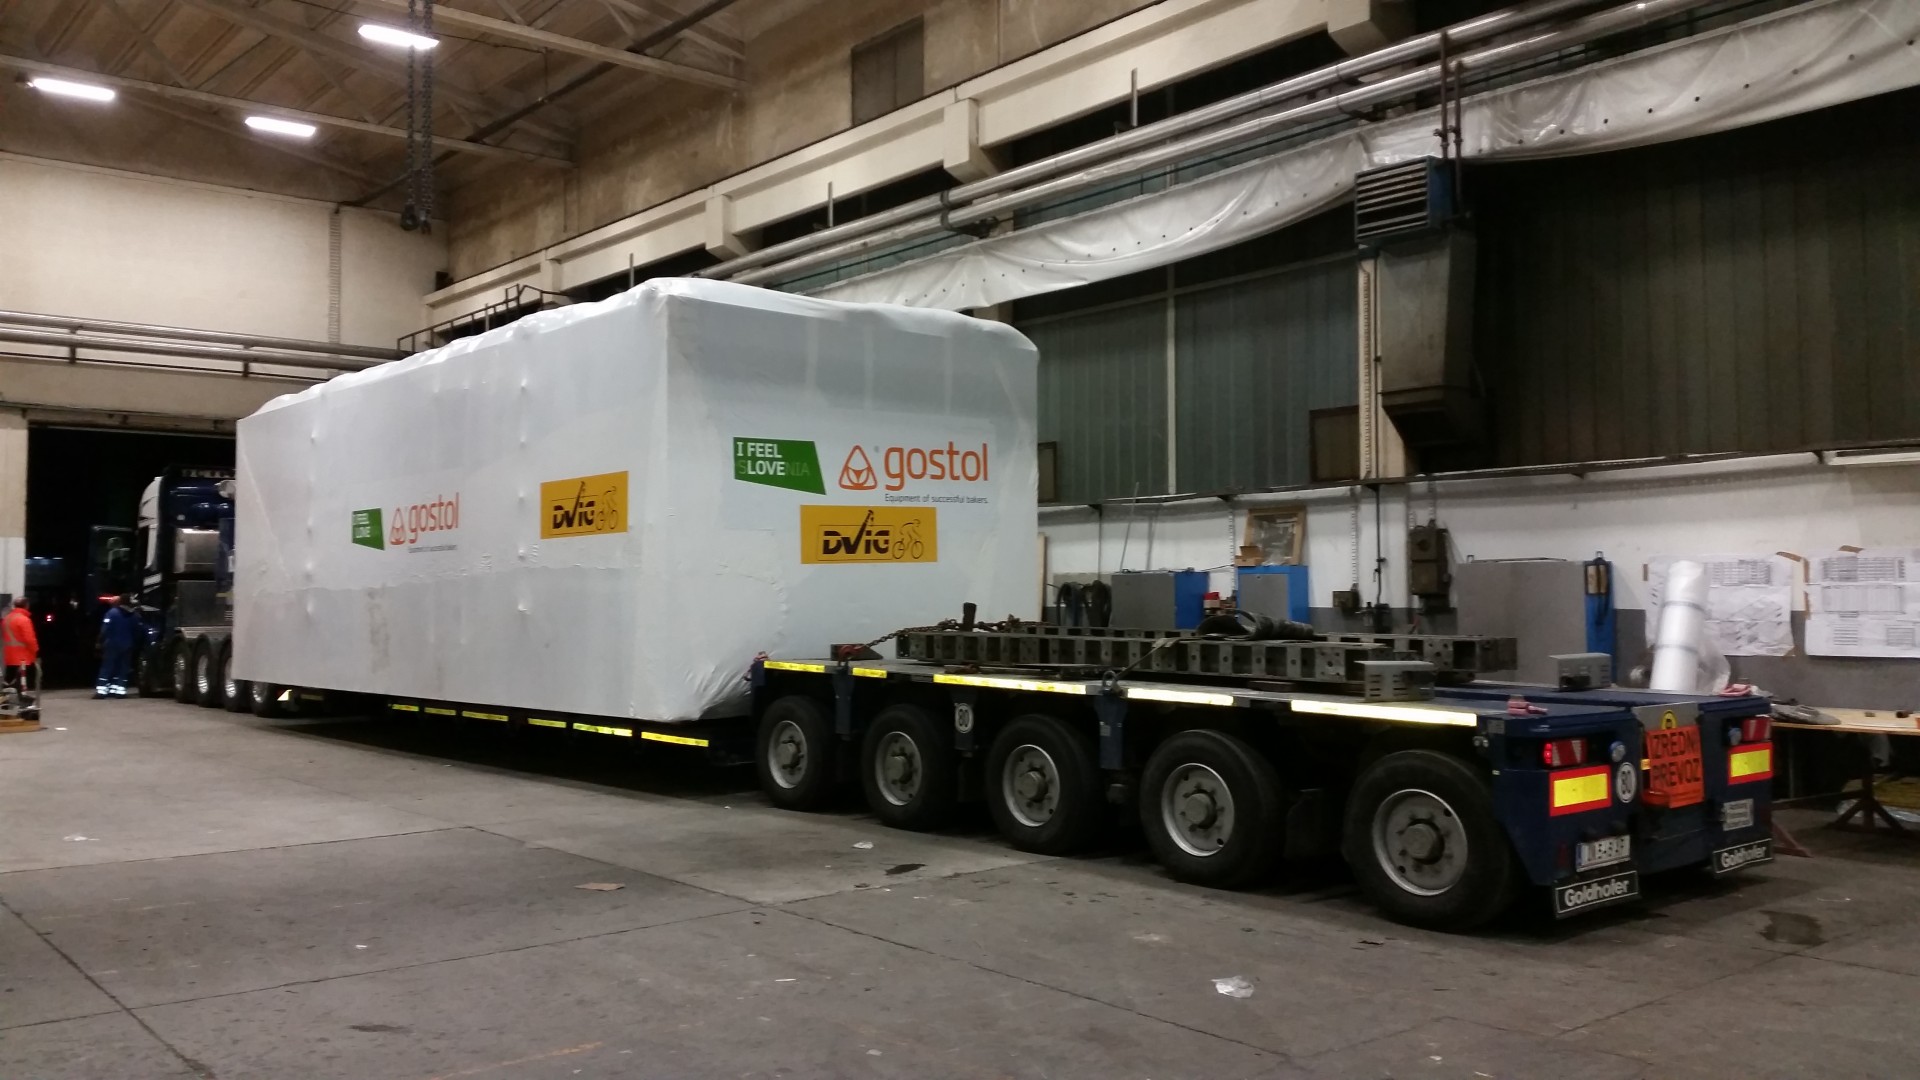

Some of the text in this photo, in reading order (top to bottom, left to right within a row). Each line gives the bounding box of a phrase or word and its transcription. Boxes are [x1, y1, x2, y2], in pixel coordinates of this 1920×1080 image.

[736, 442, 782, 458] I FEEL
[884, 441, 988, 491] gostol
[408, 492, 459, 544] gostol
[1652, 758, 1701, 790] PREVOZ
[1564, 878, 1630, 907] Goldhofer
